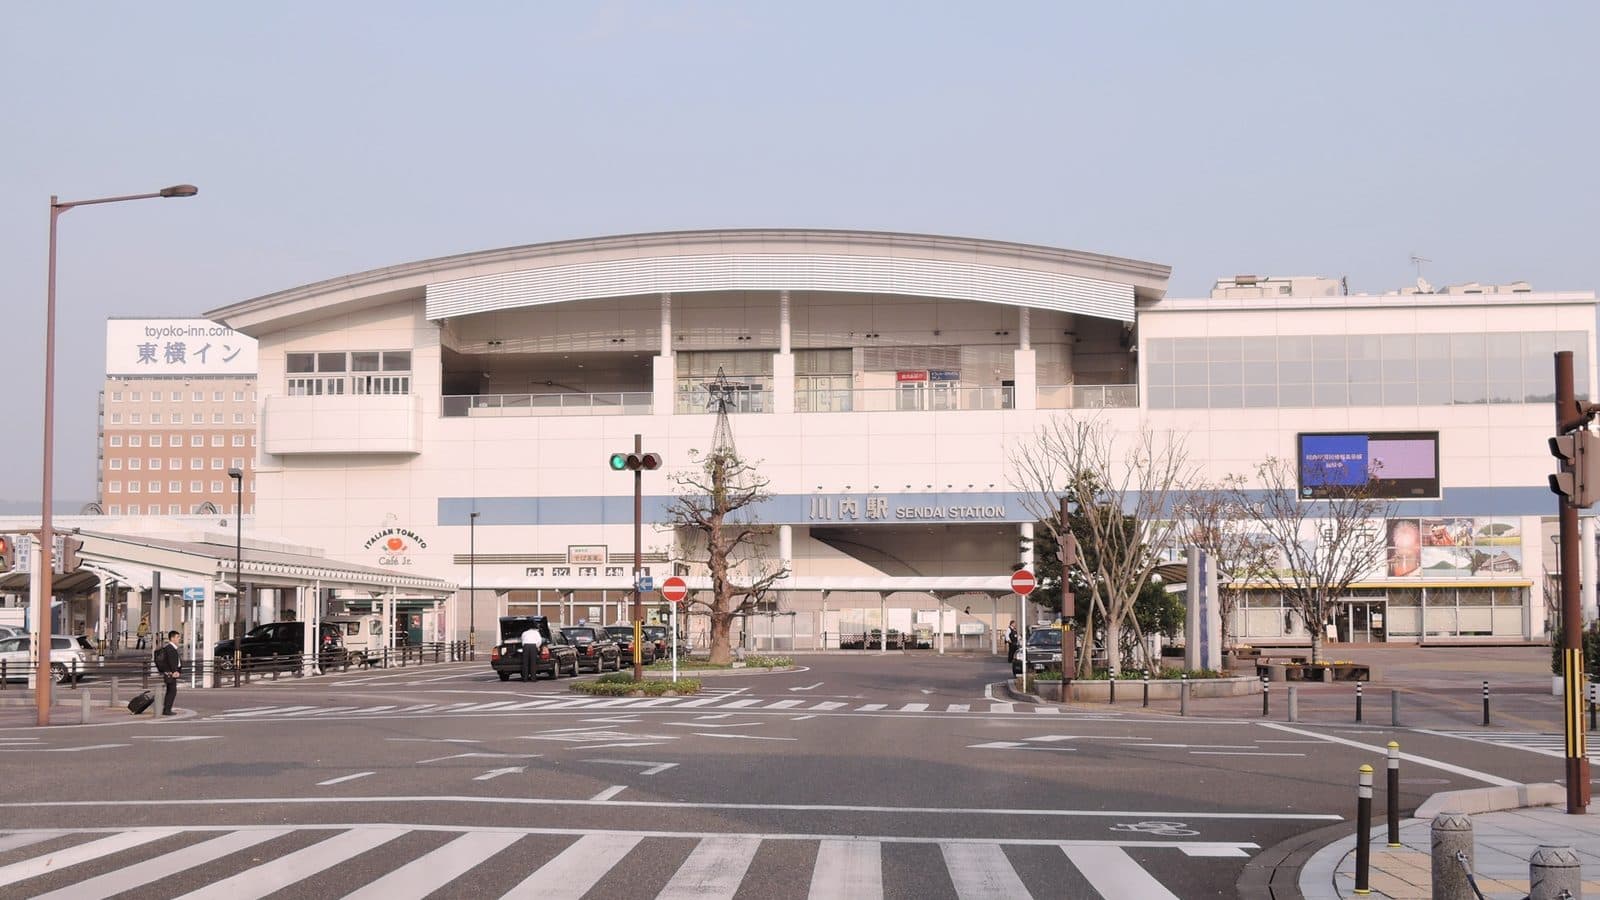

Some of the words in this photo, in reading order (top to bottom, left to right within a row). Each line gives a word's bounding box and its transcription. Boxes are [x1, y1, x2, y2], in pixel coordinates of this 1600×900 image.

[145, 325, 234, 339] toyoko-inn.com
[136, 342, 241, 364] 東横イン
[810, 496, 889, 519] 川内駅
[896, 506, 944, 519] SENDAI
[948, 506, 1005, 519] STATION
[364, 528, 393, 549] ITALIAN
[397, 528, 427, 549] TOMATO
